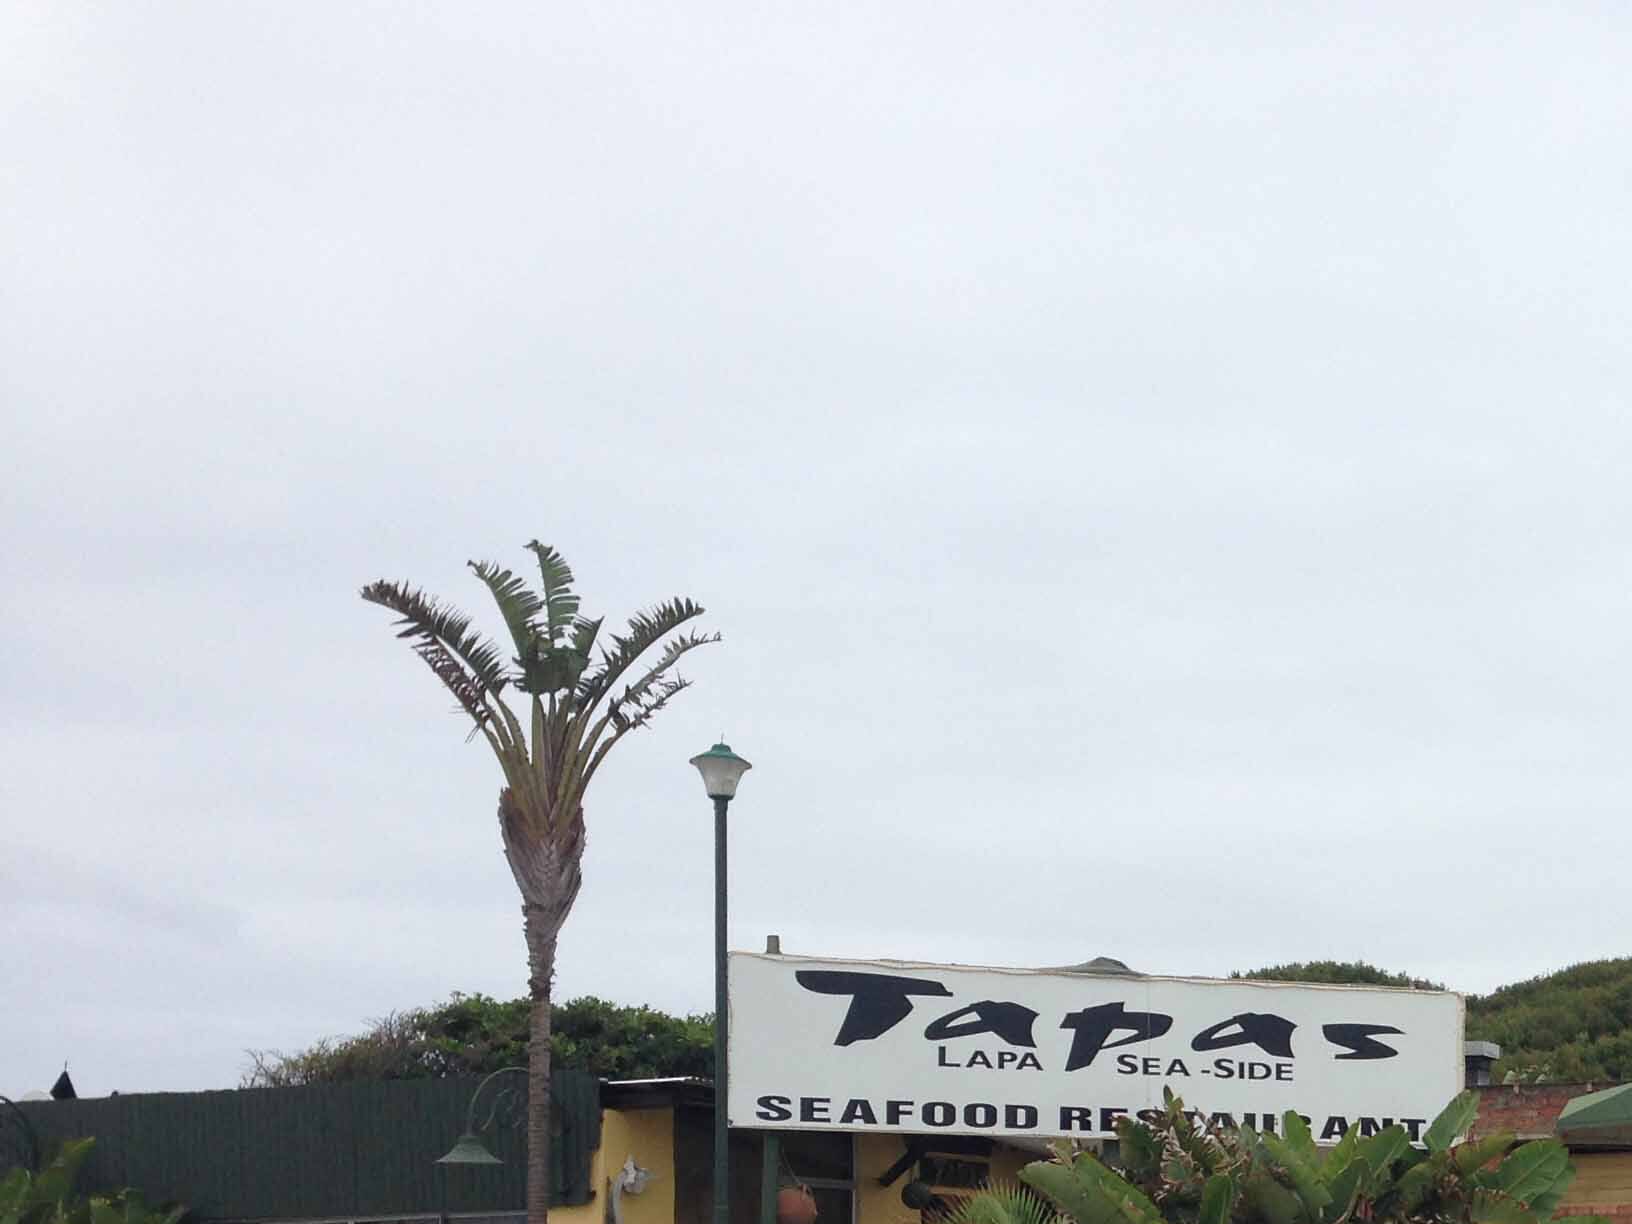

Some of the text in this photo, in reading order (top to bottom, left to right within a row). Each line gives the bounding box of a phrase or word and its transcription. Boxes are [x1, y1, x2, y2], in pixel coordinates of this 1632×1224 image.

[937, 1046, 1044, 1071] LAPA
[755, 1095, 1427, 1142] SEAFOOD REAUANT
